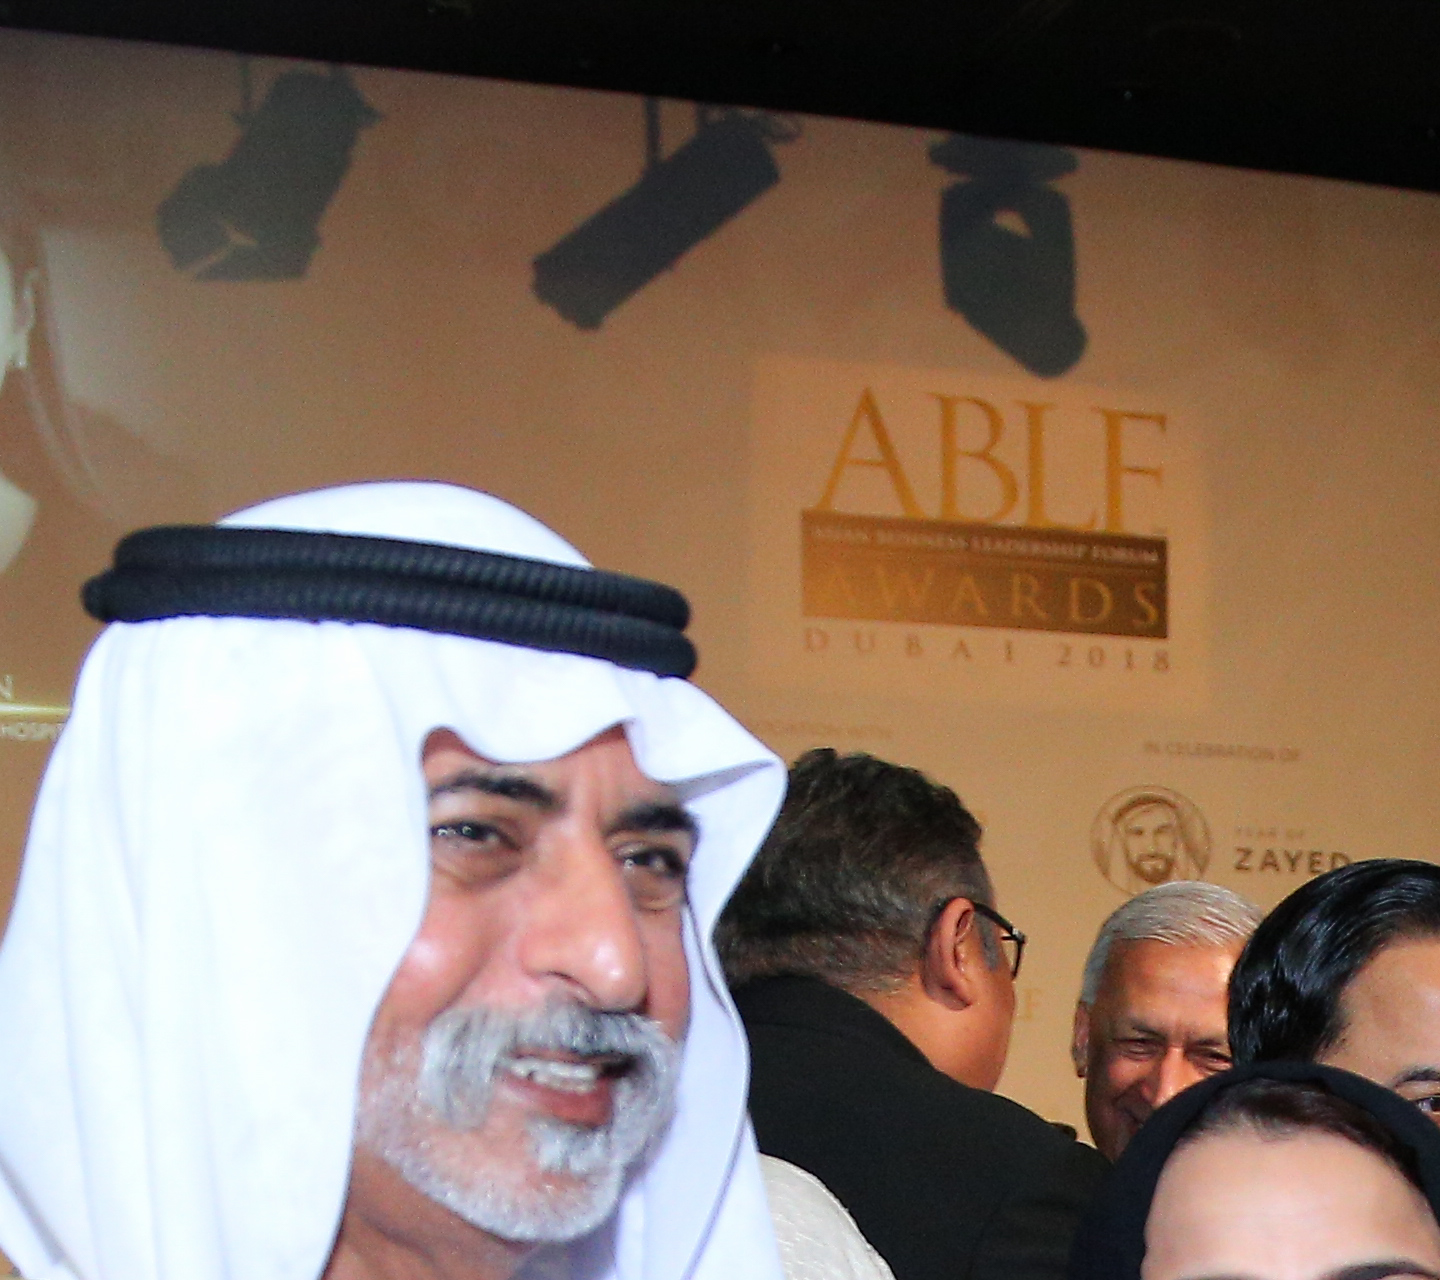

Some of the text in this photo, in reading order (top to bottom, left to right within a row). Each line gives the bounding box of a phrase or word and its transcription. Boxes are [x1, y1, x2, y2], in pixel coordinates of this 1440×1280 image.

[814, 385, 1169, 533] ABLF
[821, 561, 1161, 630] AWARDS
[804, 627, 1171, 674] DUBAI 2018
